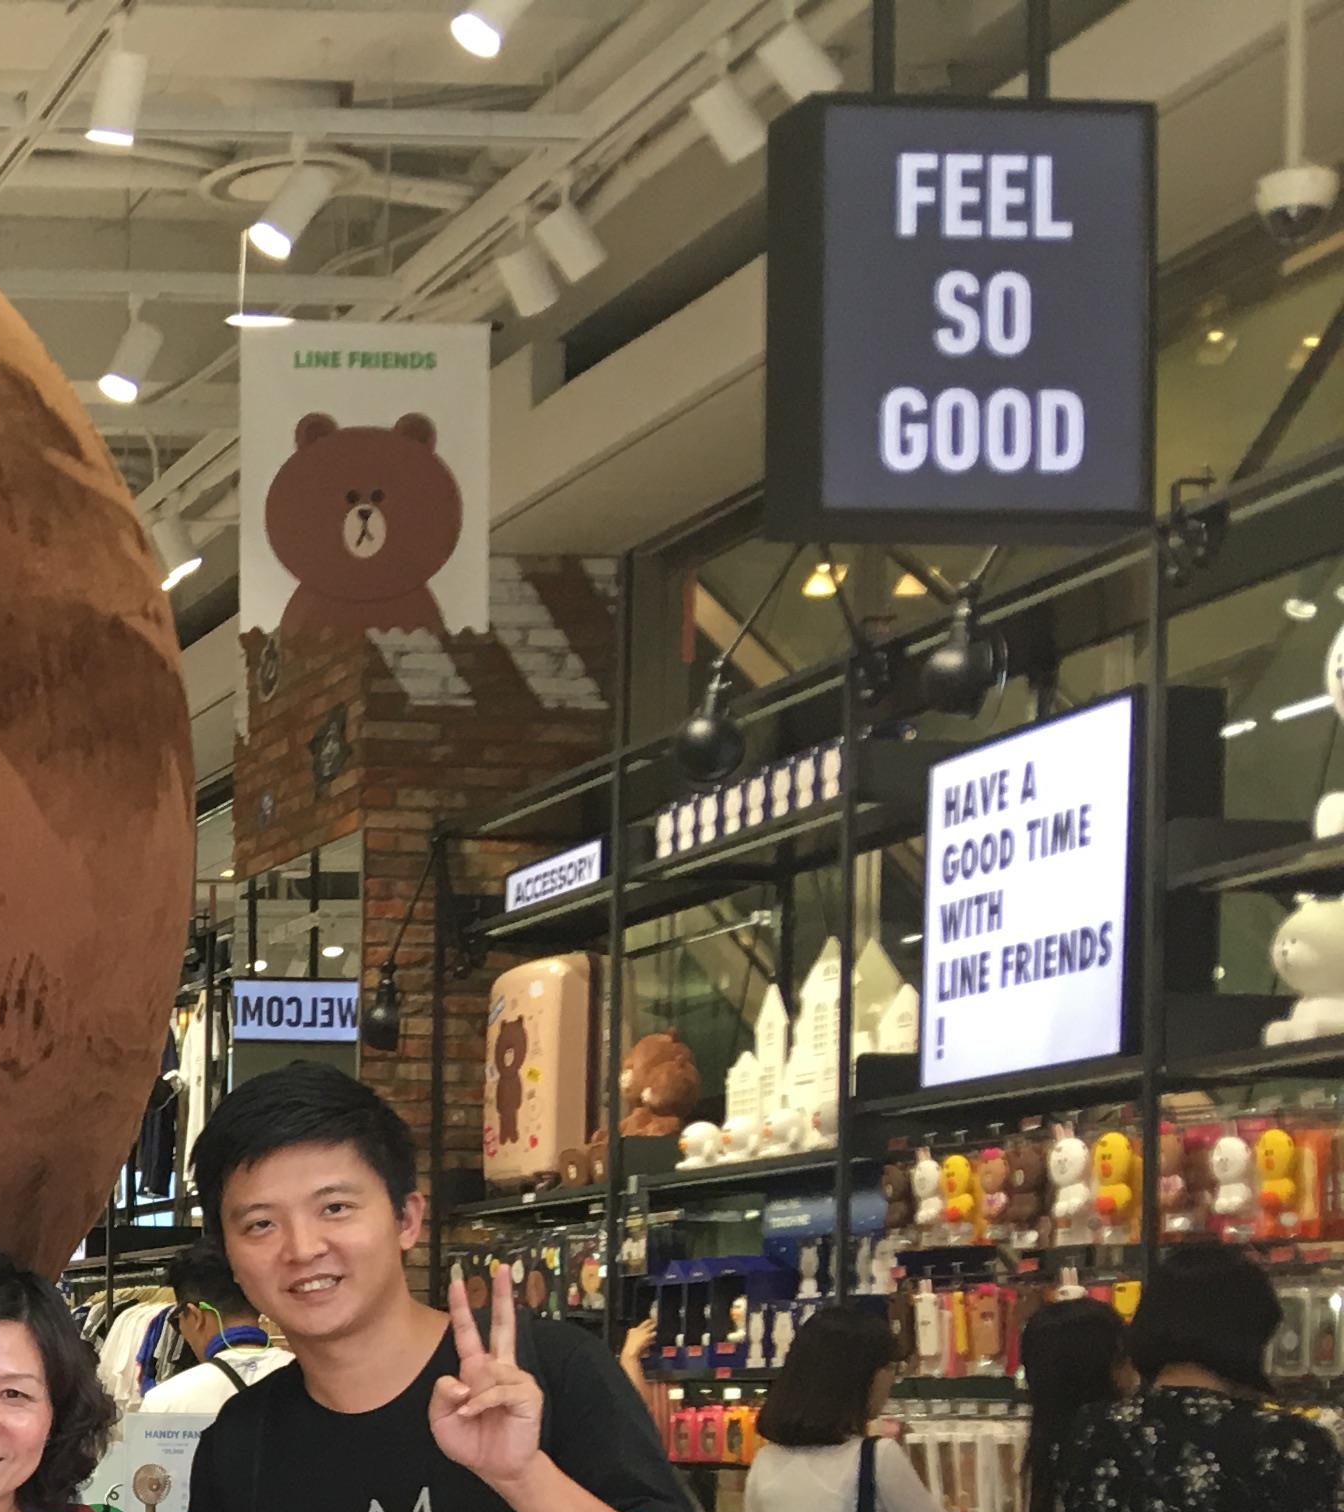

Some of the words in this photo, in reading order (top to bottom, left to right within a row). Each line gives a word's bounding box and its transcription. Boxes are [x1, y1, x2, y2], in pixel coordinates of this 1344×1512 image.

[897, 153, 1073, 239] FEEL
[934, 270, 1032, 356] SO
[293, 351, 341, 369] LINE
[348, 351, 437, 369] FRIENDS
[881, 386, 1085, 472] GOOD
[944, 769, 1009, 828] HAVE
[1021, 761, 1037, 804] A
[943, 828, 1015, 885] GOOD
[1027, 804, 1091, 861] TIME
[515, 852, 597, 905] ACCESSORY
[941, 889, 1003, 944] WITH
[938, 951, 991, 1002] LINE
[1000, 921, 1113, 988] FRIENDS
[937, 1017, 945, 1060] !
[144, 1430, 179, 1440] HANDY
